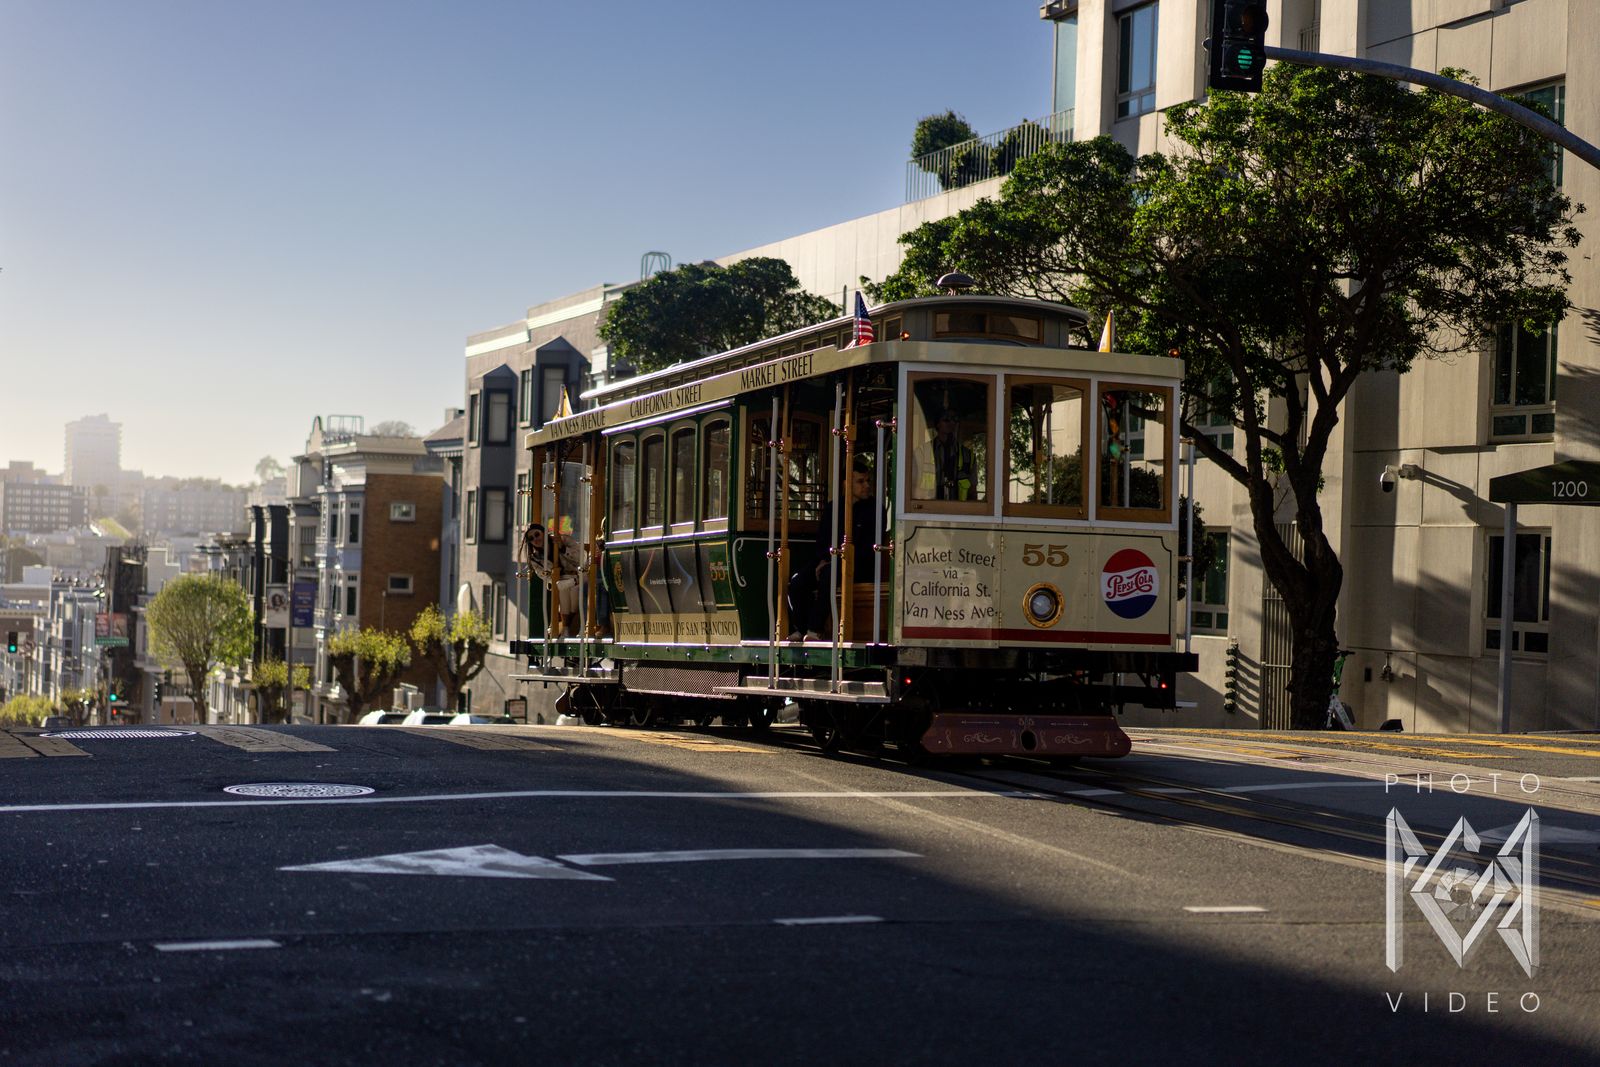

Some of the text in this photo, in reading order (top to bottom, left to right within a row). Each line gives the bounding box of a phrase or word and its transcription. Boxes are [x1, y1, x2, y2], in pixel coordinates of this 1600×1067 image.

[740, 353, 814, 390] MARKET STREET
[630, 383, 703, 419] CALIFORNIA STREET
[551, 409, 606, 438] VAN NESS AVENUE
[1551, 481, 1588, 497] 1200
[906, 548, 997, 568] Market Street
[1022, 543, 1069, 567] 55
[709, 561, 726, 582] 55
[942, 568, 958, 579] via
[911, 581, 991, 598] California St.
[1106, 569, 1154, 600] PEPSI-COLA
[905, 601, 998, 621] Van Ness Ave.
[648, 621, 674, 635] RAILWAY
[676, 622, 686, 635] OF
[687, 622, 699, 635] SAN
[700, 621, 738, 636] FRANCISCO
